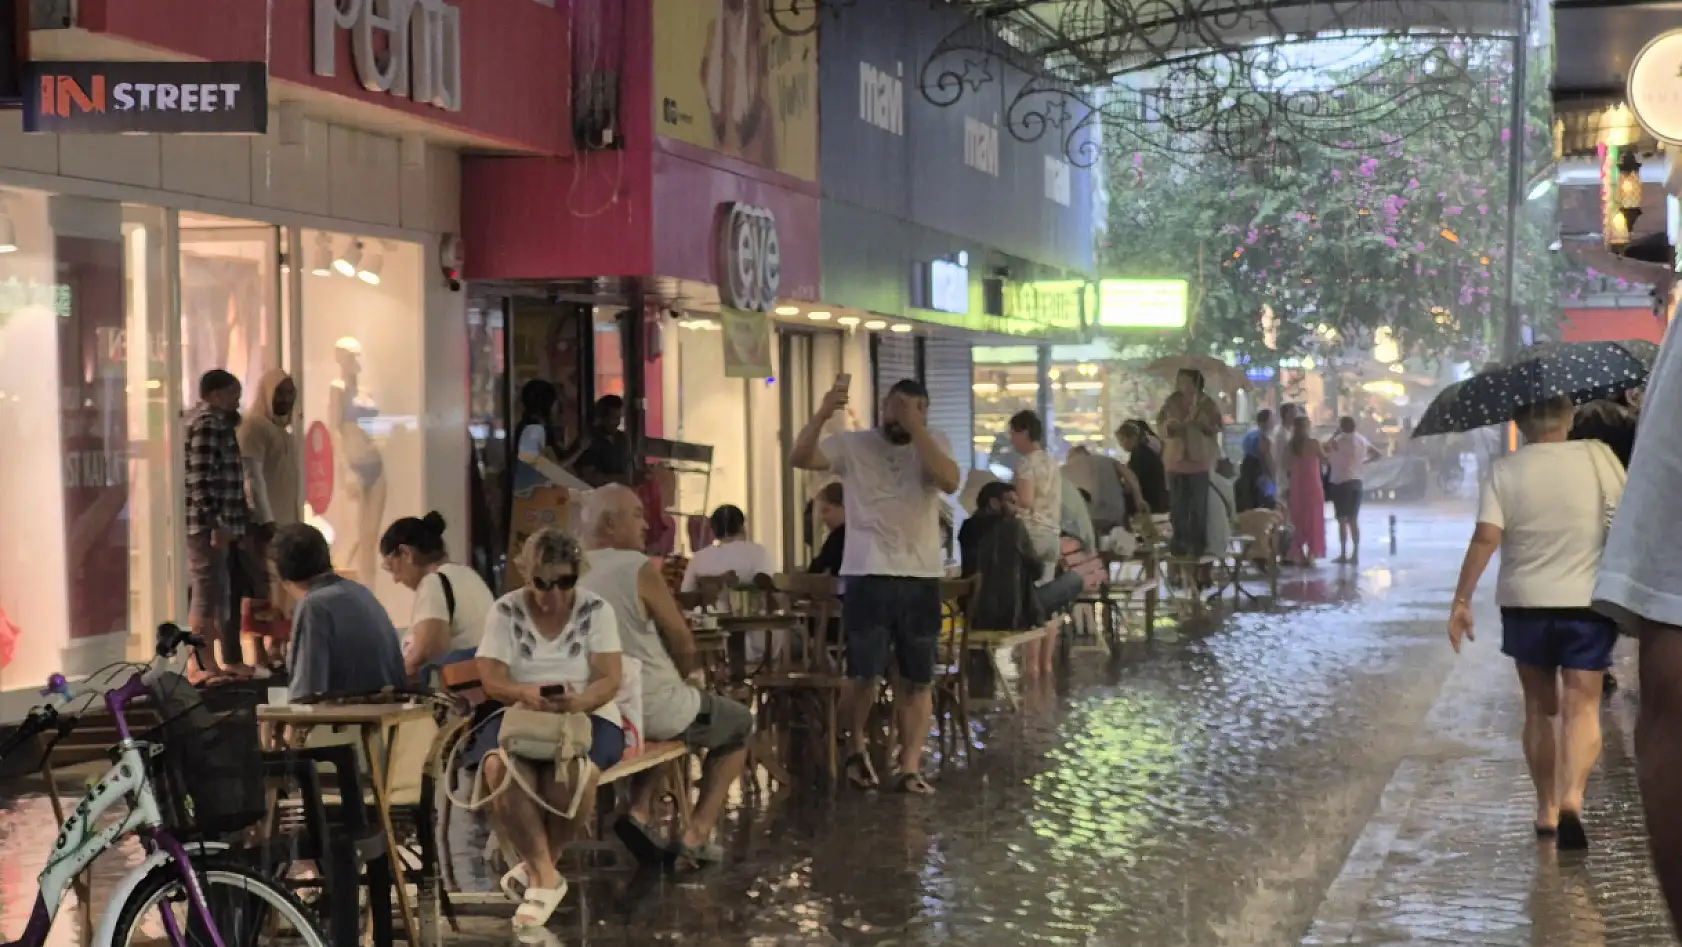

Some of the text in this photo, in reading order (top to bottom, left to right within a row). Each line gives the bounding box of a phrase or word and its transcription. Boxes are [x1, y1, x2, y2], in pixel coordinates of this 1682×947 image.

[40, 74, 241, 118] IN STREET
[859, 60, 904, 136] mavi
[963, 109, 999, 178] mavi
